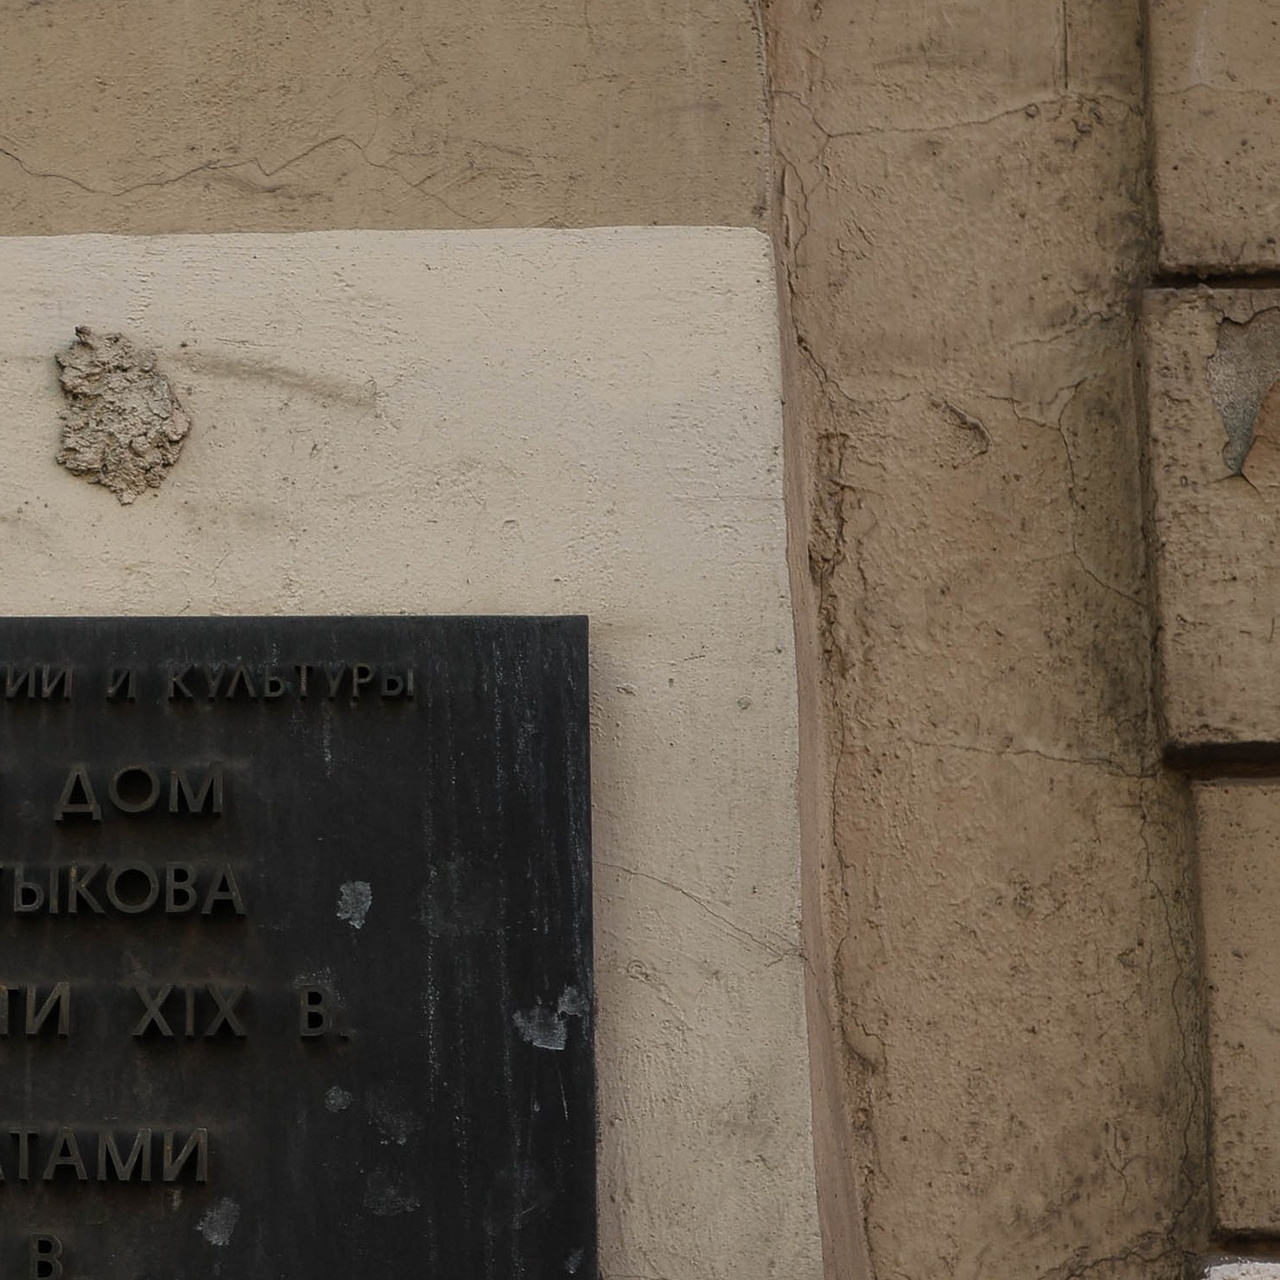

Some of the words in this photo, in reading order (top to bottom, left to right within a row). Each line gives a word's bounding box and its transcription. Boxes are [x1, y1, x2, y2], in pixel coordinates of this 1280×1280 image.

[106, 666, 138, 700] И
[167, 661, 414, 702] КУЛЬТУРЫ
[55, 762, 224, 822] ДОМ
[132, 983, 248, 1038] XIX
[298, 984, 351, 1040] В.
